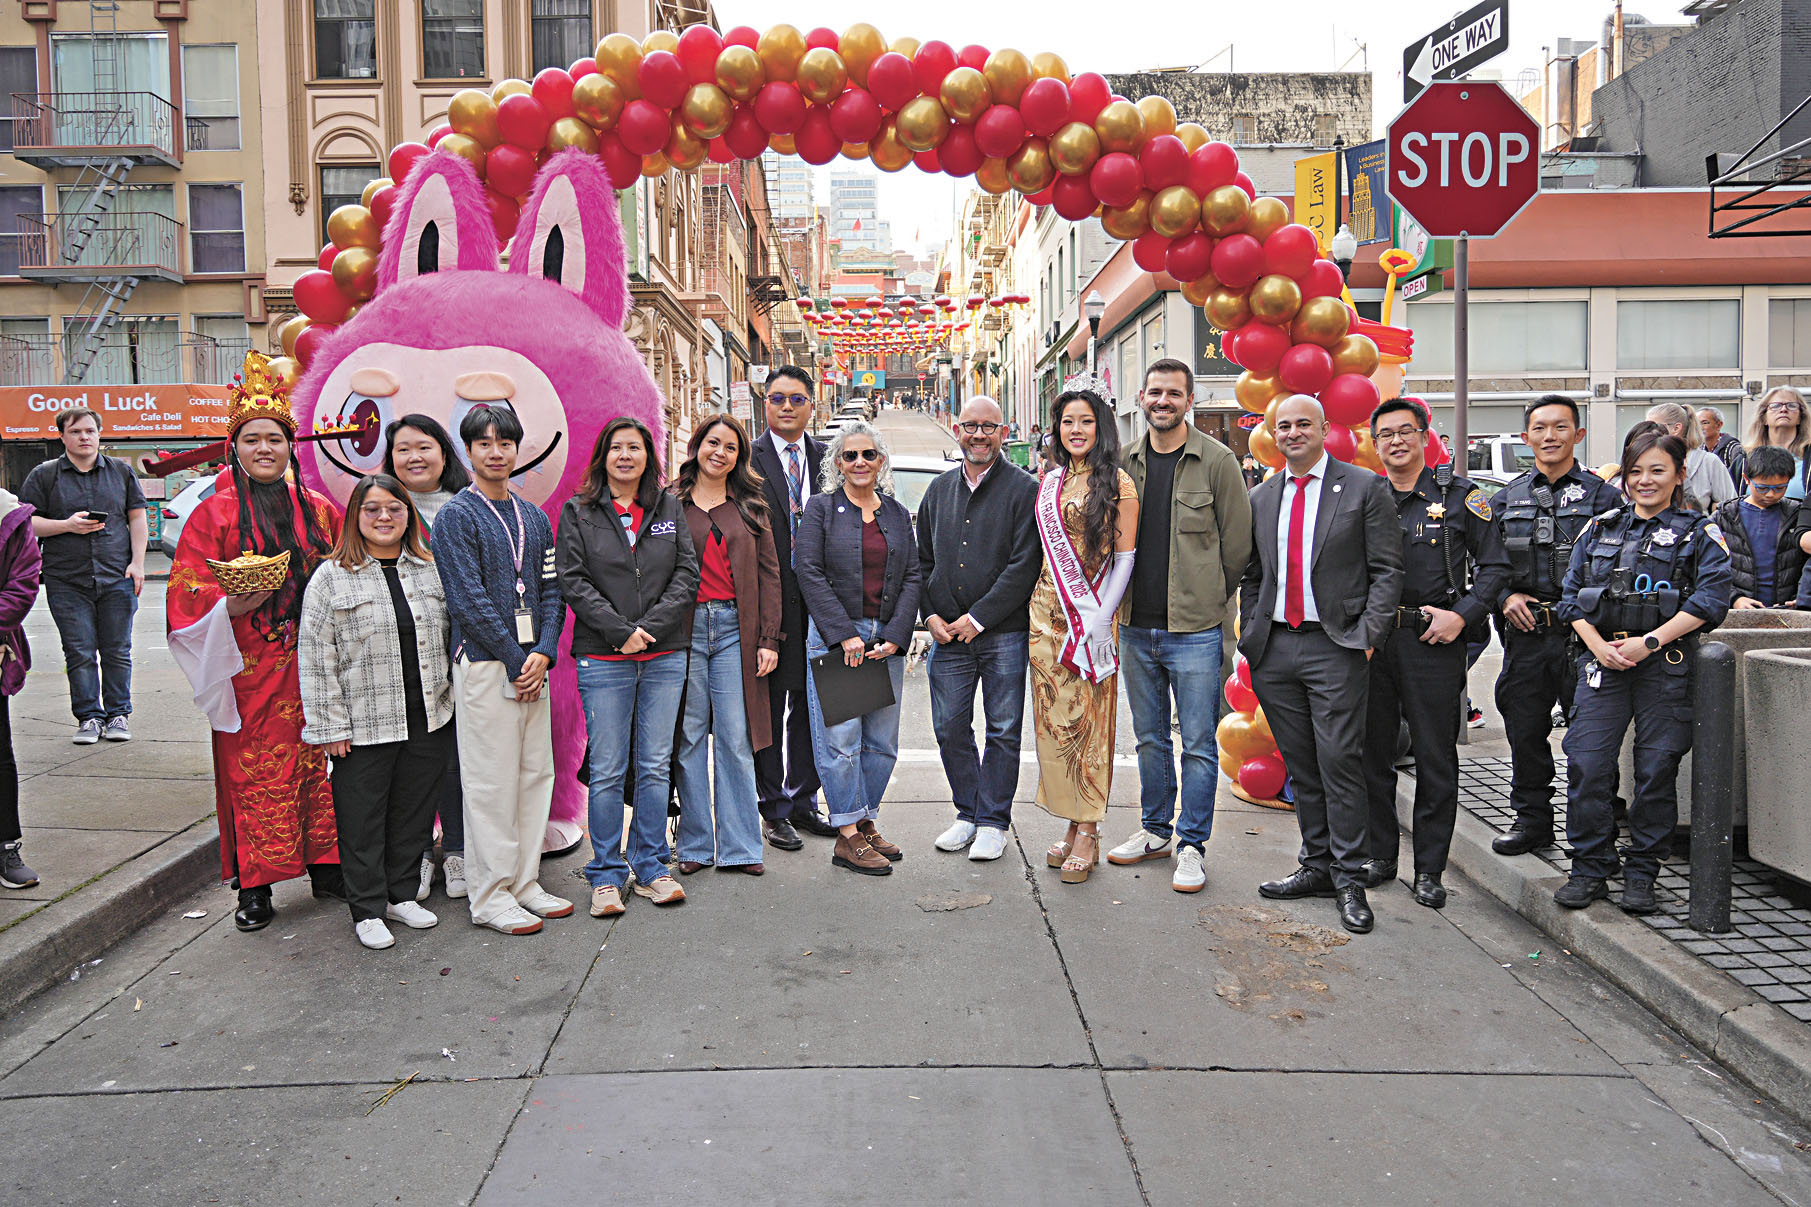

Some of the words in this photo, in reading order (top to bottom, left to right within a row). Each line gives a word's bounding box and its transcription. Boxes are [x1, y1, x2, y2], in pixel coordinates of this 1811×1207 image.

[1432, 35, 1460, 70] ONE
[1465, 13, 1496, 52] WAY
[1358, 153, 1380, 163] Leaders
[1398, 131, 1530, 188] STOP
[1310, 168, 1324, 208] Law
[1403, 278, 1425, 297] OPEN
[28, 393, 88, 412] Good
[104, 392, 157, 411] Luck
[189, 398, 223, 406] COFFEE
[140, 412, 161, 421] Cafe
[163, 412, 182, 421] Deli
[112, 424, 154, 432] Sandwiches
[1040, 502, 1063, 543] FRANCISCO
[1053, 541, 1081, 583] CHINATOWN
[1069, 580, 1089, 599] 2025
